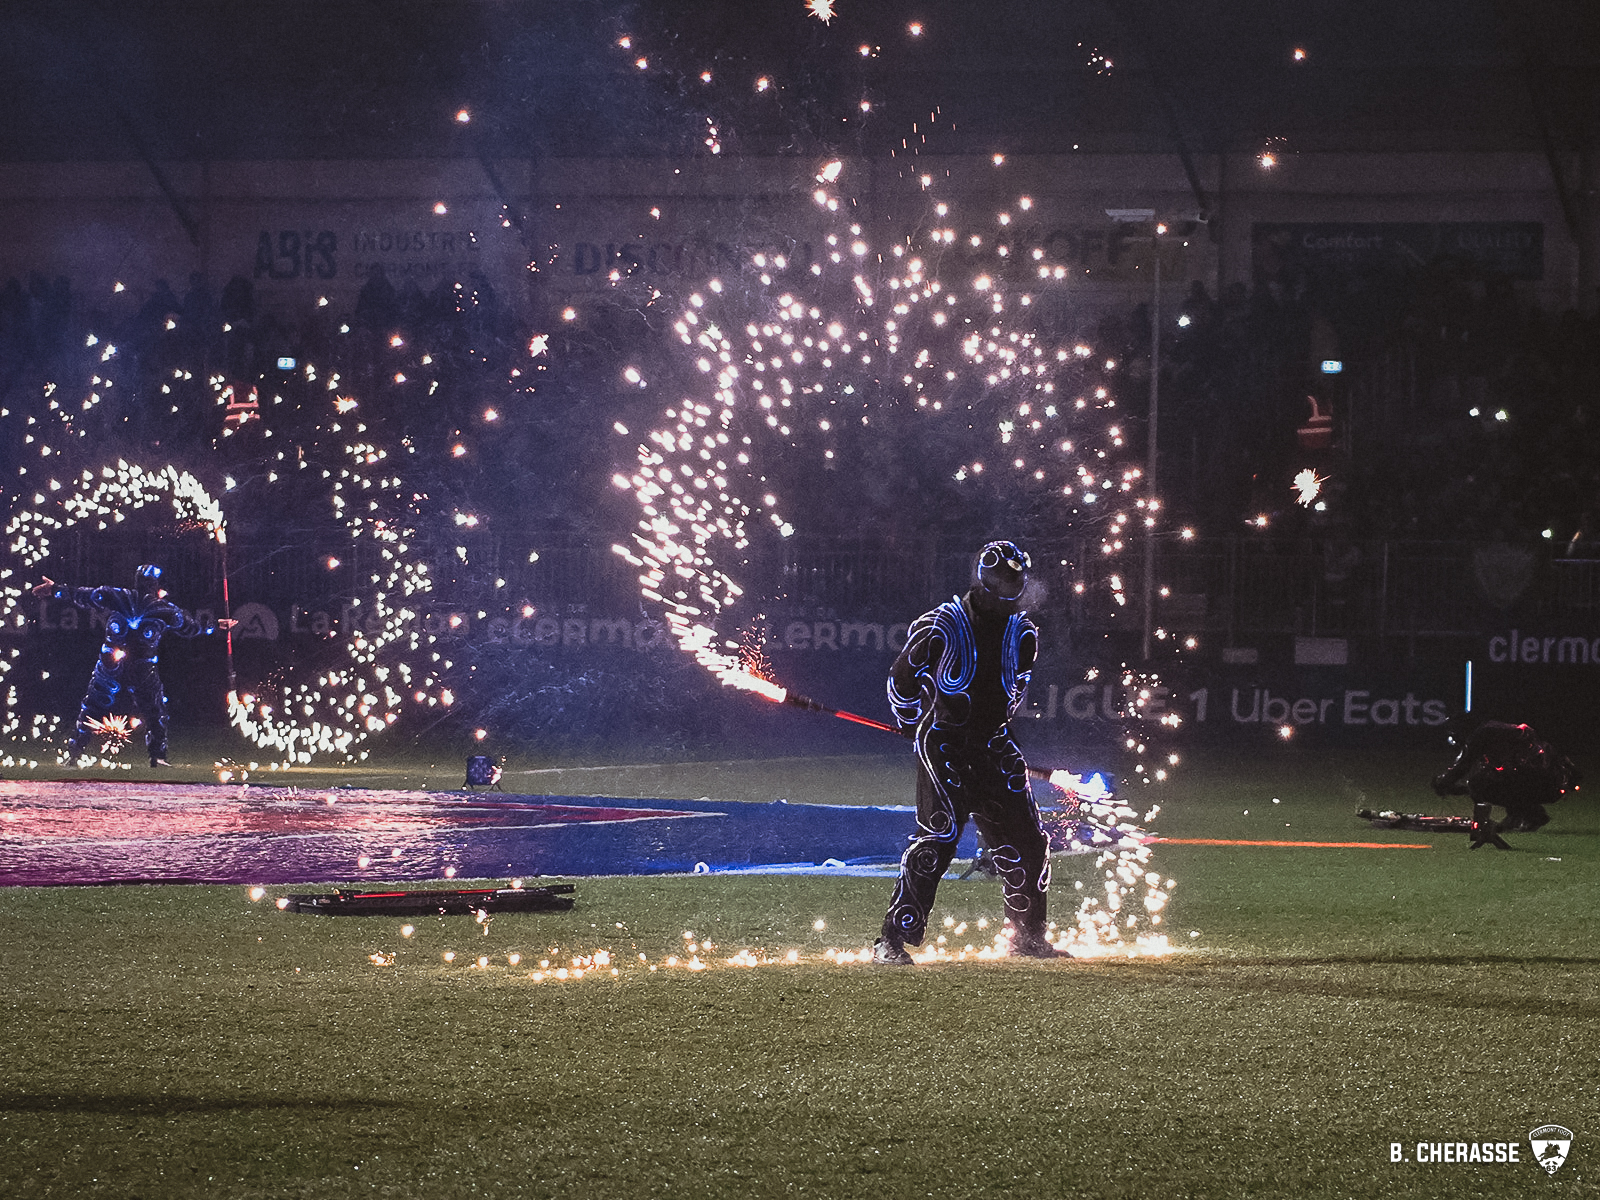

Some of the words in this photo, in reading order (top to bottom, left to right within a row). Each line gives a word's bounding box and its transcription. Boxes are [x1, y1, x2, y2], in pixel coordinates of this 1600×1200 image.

[1302, 231, 1383, 250] Comfort
[40, 600, 78, 630] La
[289, 602, 331, 634] La
[1017, 683, 1171, 720] LIGUE
[1189, 687, 1208, 722] 1
[1231, 688, 1334, 724] Uber
[1343, 689, 1448, 725] Eats
